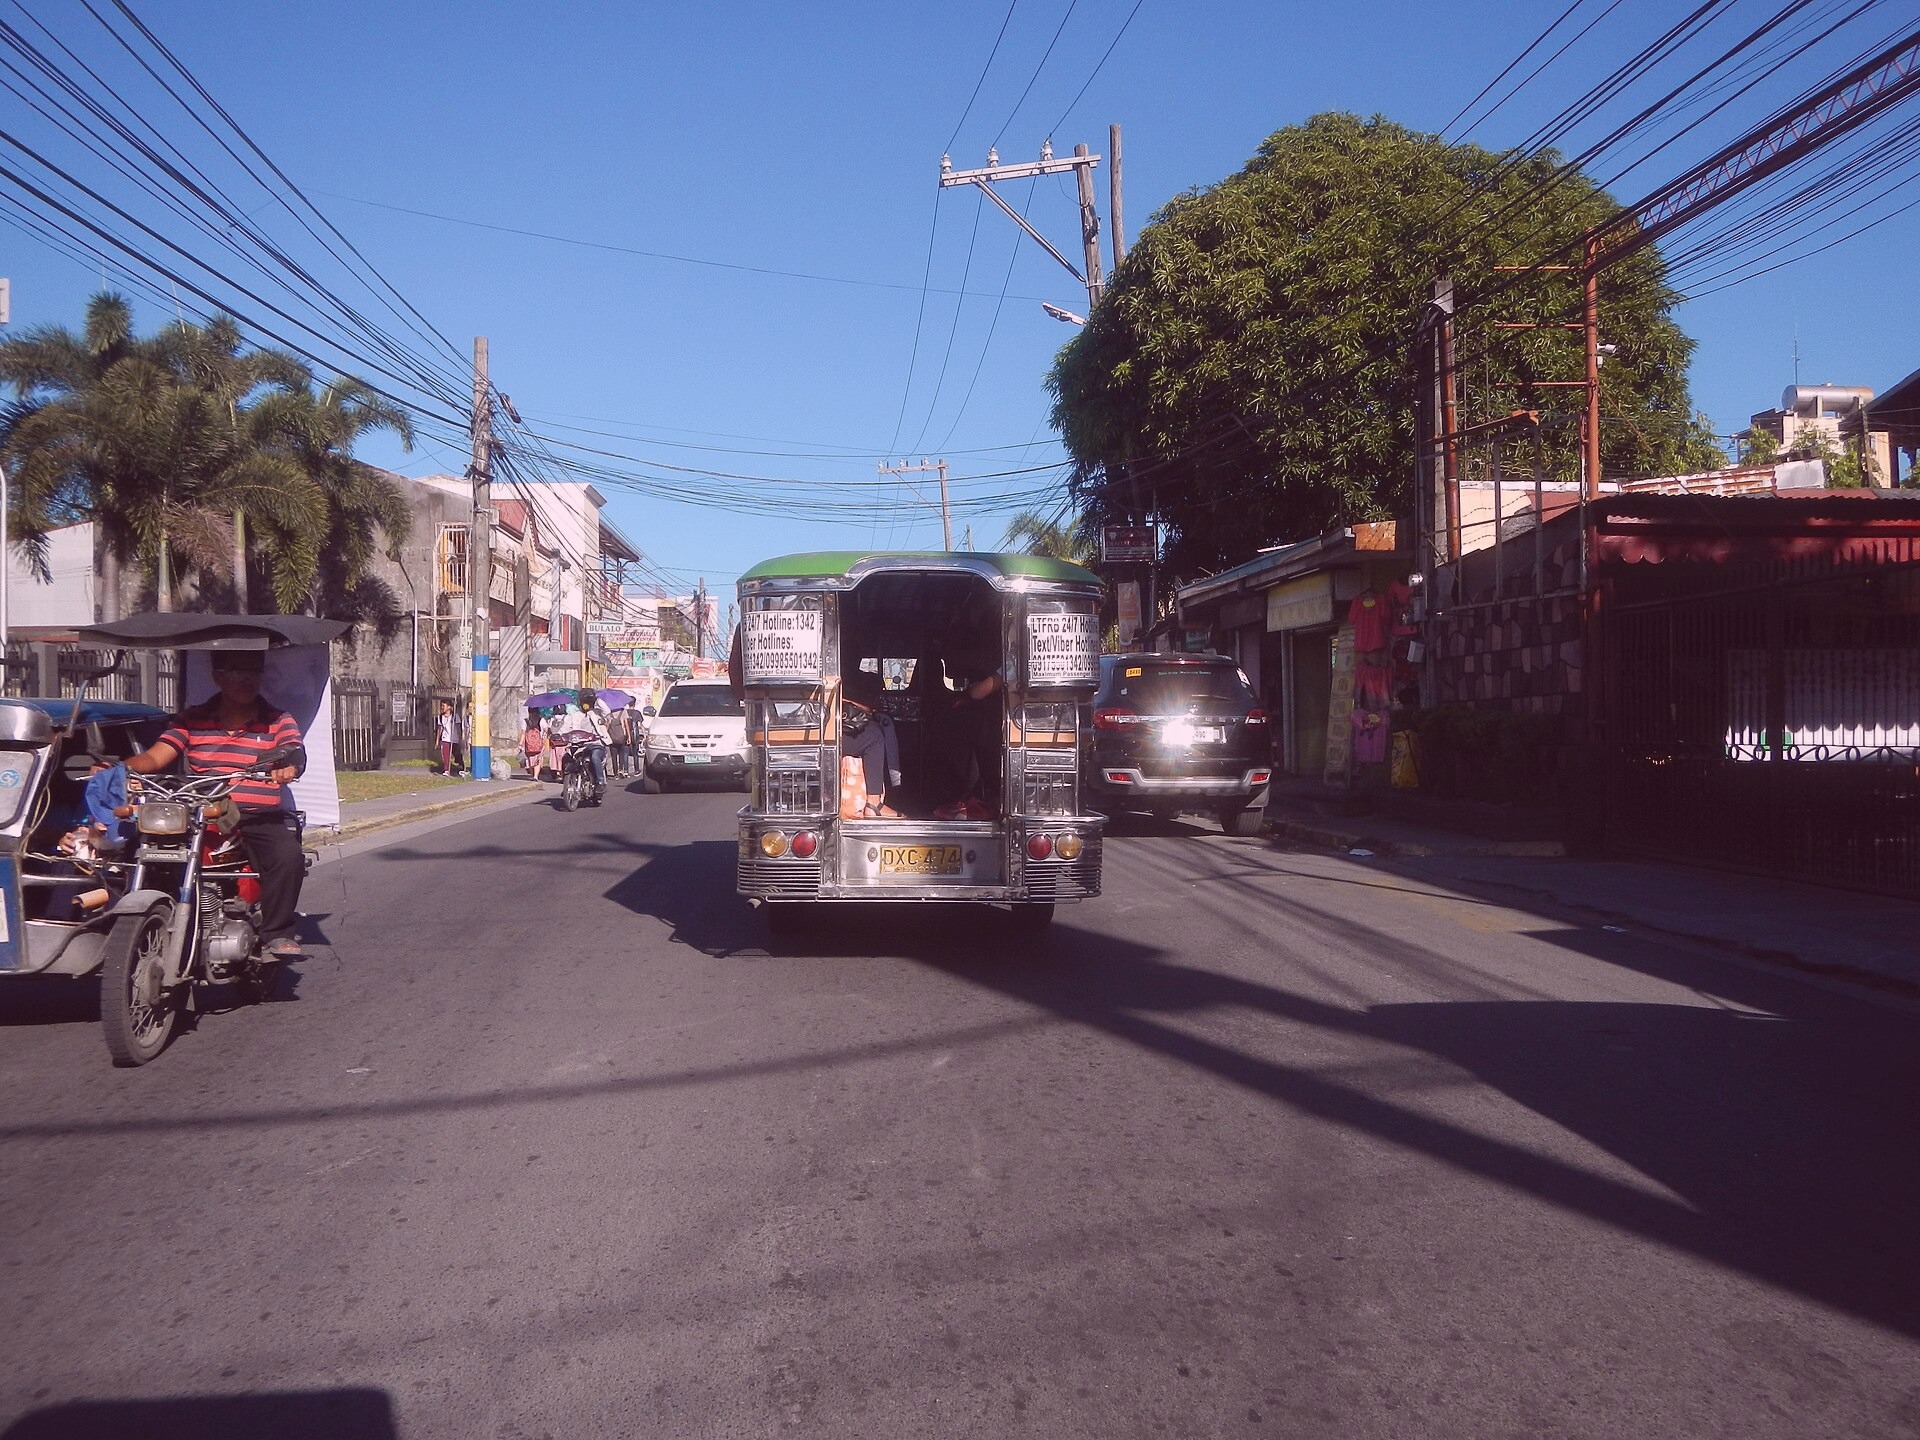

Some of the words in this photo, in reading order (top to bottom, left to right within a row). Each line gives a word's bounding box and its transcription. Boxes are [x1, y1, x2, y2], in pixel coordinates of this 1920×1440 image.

[589, 624, 621, 632] BULALO
[1062, 615, 1078, 633] 24/7
[757, 632, 794, 650] Hotlines:
[1032, 634, 1073, 653] Text/Viber
[775, 668, 802, 676] Capacity
